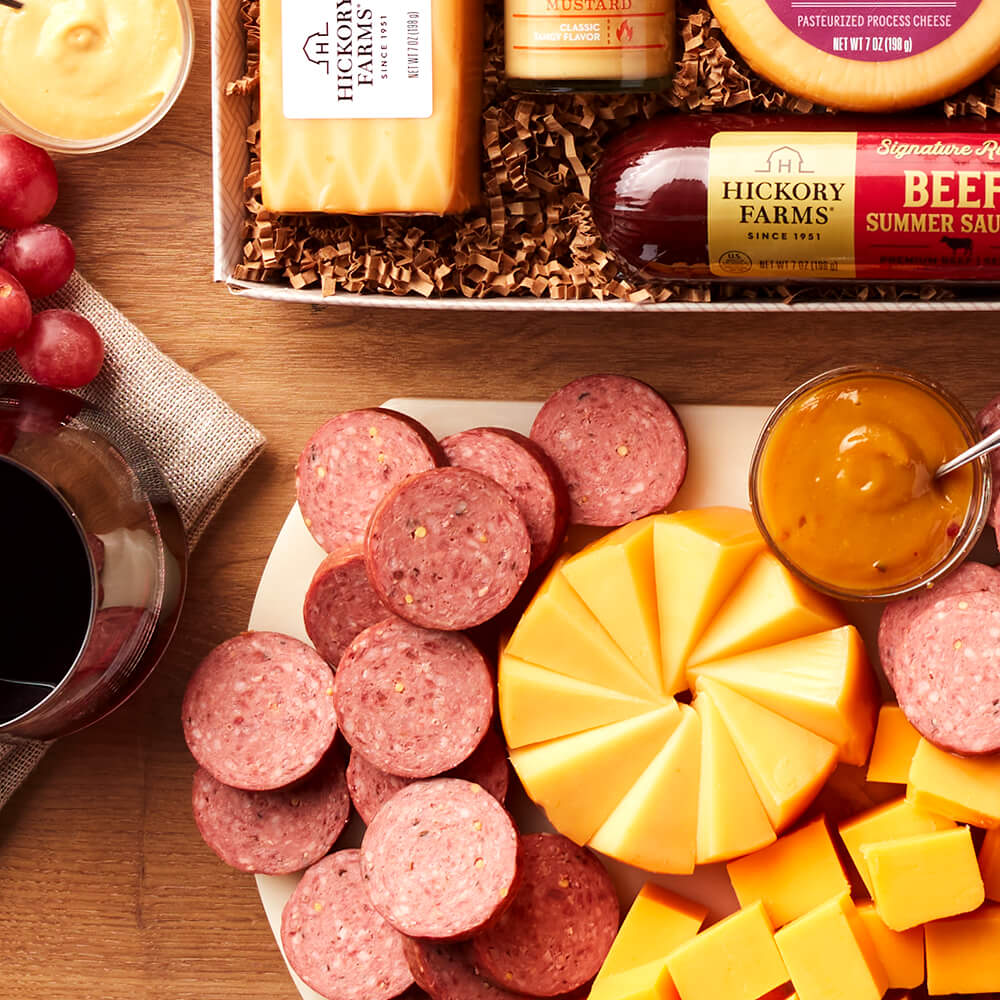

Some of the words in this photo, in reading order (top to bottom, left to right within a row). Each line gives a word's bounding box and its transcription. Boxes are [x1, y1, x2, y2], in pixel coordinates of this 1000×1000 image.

[560, 23, 600, 32] CLASSIC
[797, 15, 864, 28] PASTEURIZED
[867, 15, 911, 28] PROCESS
[913, 15, 952, 28] CHEESE
[563, 32, 600, 41] FLAVOR
[316, 42, 329, 54] H
[357, 9, 373, 86] FARMS
[833, 37, 848, 51] NET
[850, 37, 863, 51] WT
[865, 37, 871, 51] 7
[872, 37, 883, 51] OZ
[884, 37, 903, 53] (198
[407, 53, 419, 65] WT
[407, 66, 419, 79] NET
[877, 139, 973, 160] Signature
[779, 159, 791, 172] H
[723, 182, 845, 201] HICKORY
[739, 205, 828, 225] FARMS
[866, 213, 955, 233] SUMMER
[748, 232, 788, 241] SINCE
[794, 232, 821, 241] 1951
[777, 260, 788, 269] WT
